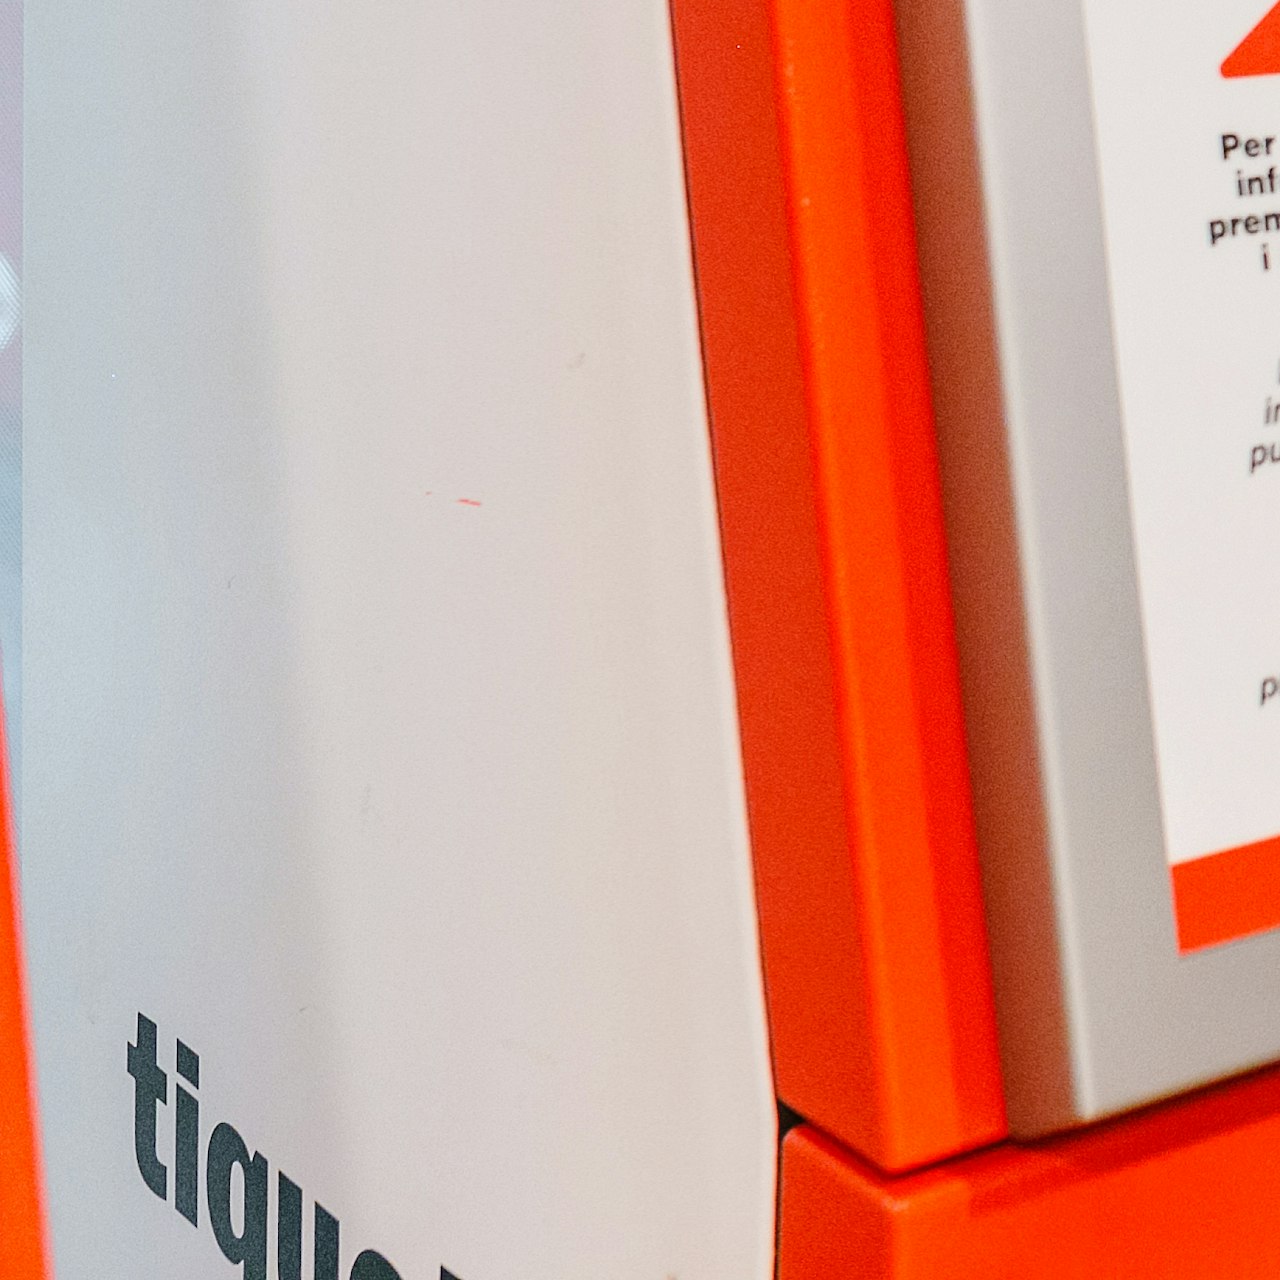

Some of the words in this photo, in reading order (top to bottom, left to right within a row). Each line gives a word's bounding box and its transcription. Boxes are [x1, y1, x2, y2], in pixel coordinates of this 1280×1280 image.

[1221, 133, 1274, 160] Per
[1262, 243, 1269, 270] i
[127, 1011, 460, 1280] tiqu
